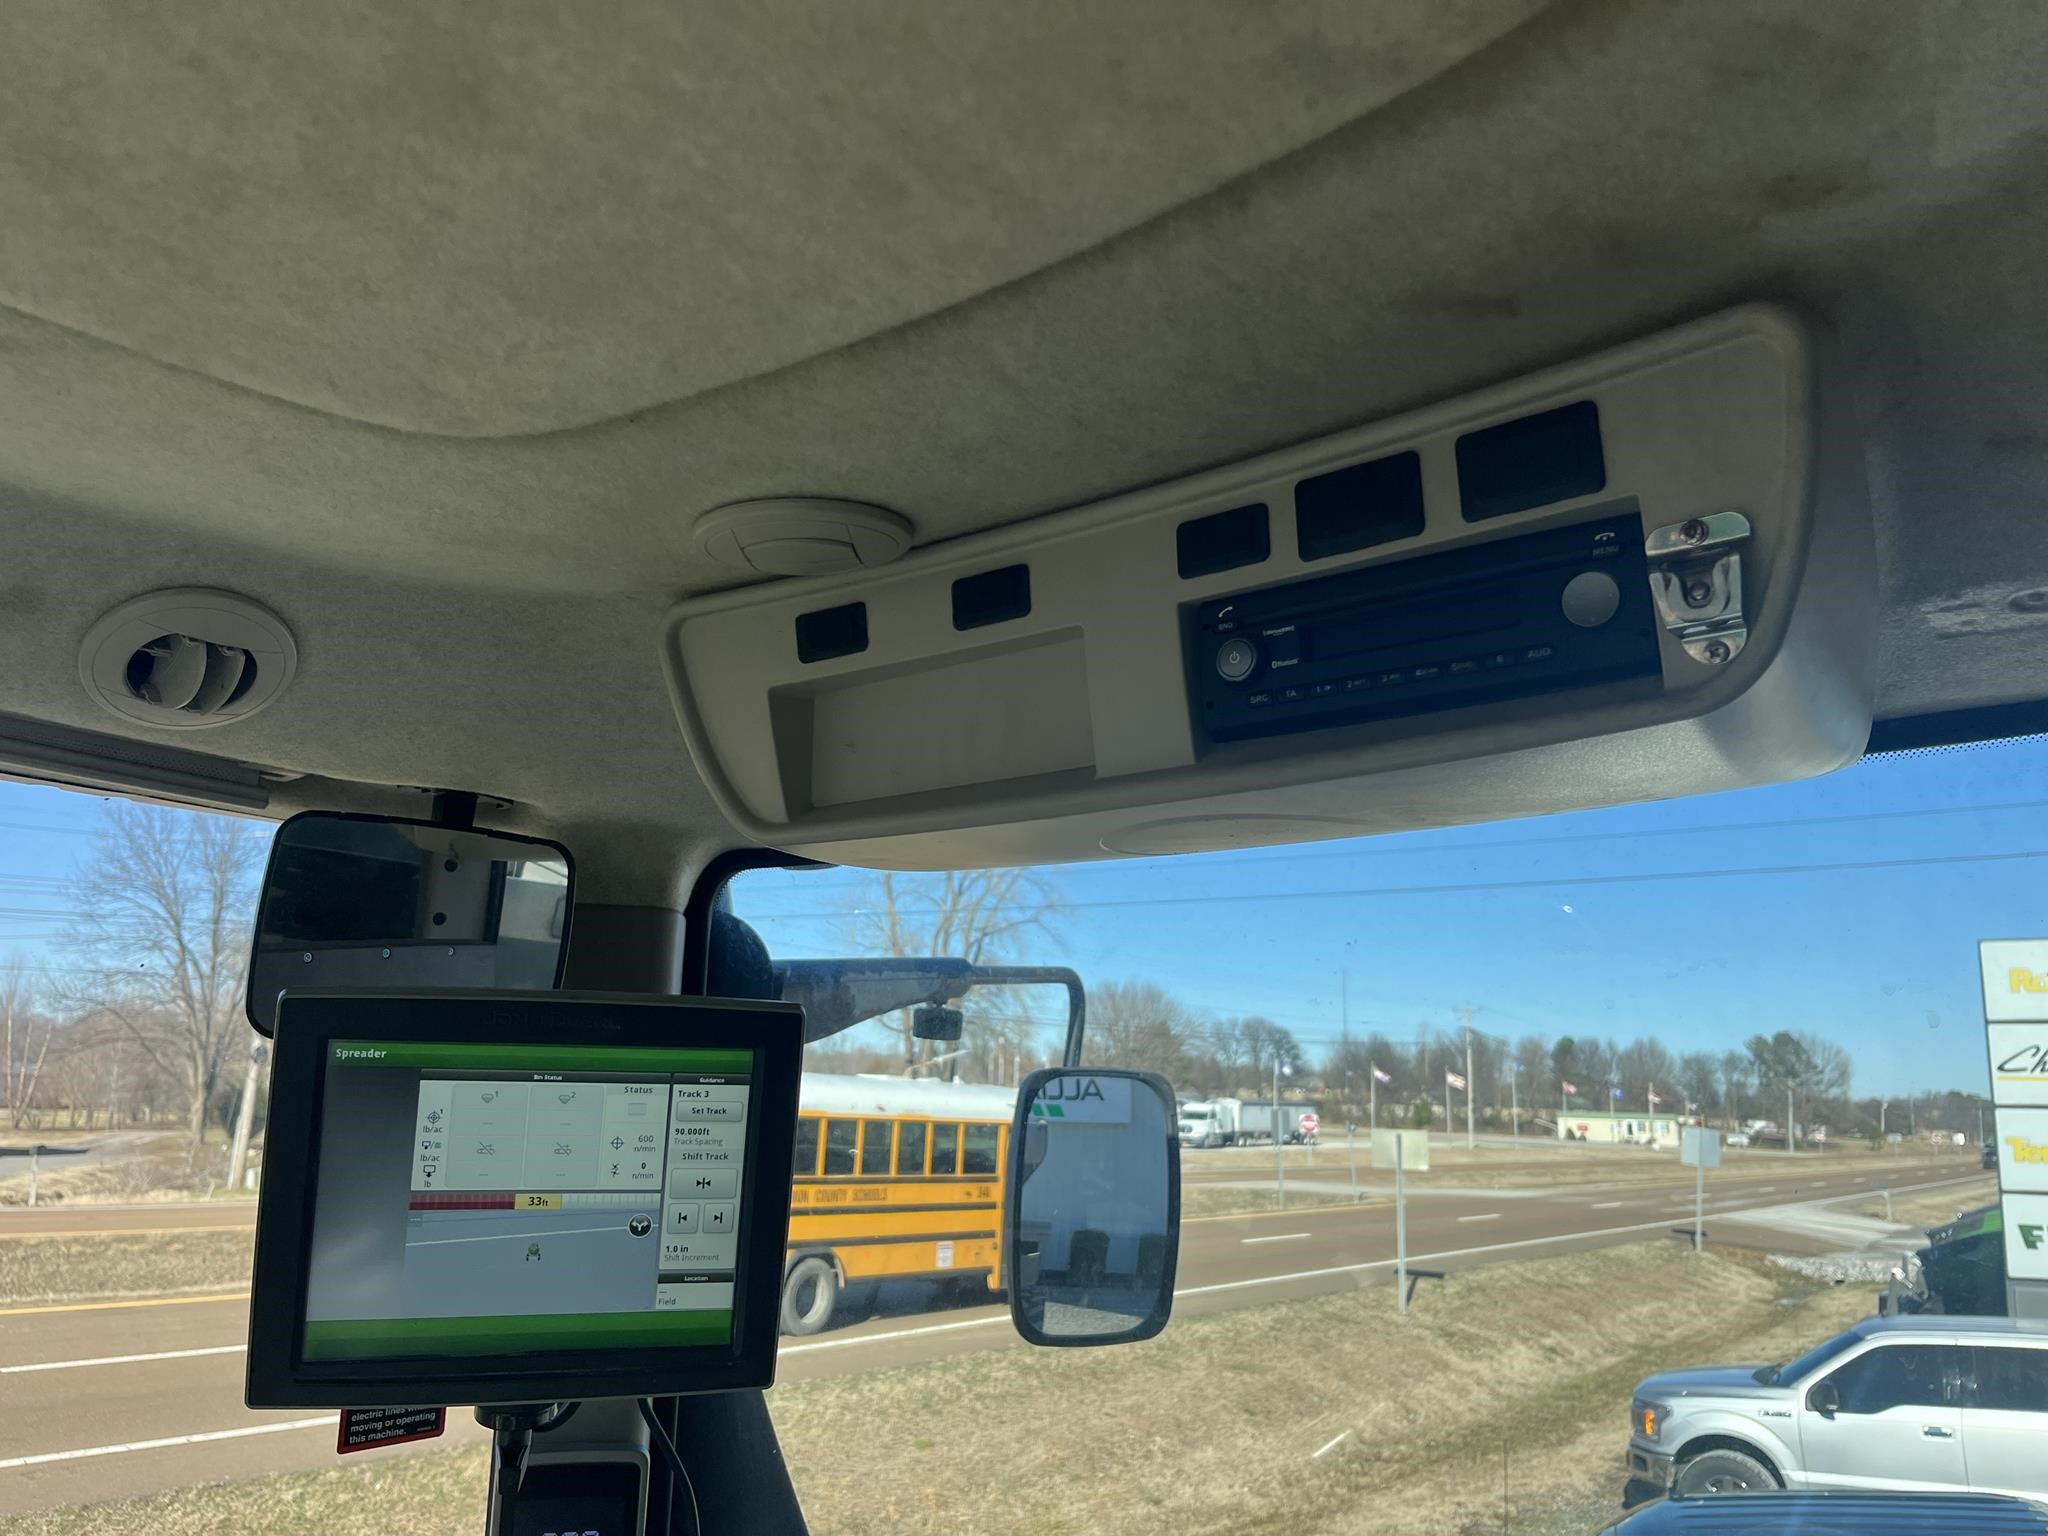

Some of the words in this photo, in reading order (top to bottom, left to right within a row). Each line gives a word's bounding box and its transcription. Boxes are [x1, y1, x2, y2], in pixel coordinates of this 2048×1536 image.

[1249, 694, 1269, 704] SRC
[335, 1048, 387, 1060] Spreader
[624, 1085, 654, 1095] Status
[678, 1089, 701, 1098] Track
[704, 1090, 710, 1098] 3
[691, 1107, 704, 1115] Set
[706, 1107, 727, 1115] Track
[422, 1125, 443, 1134] lb/ac
[674, 1127, 710, 1136] 90.000ft
[638, 1135, 654, 1143] 600
[673, 1137, 693, 1145] Track
[695, 1138, 724, 1147] Spacing
[420, 1153, 441, 1162] lb/ac
[682, 1152, 703, 1161] Shift
[705, 1152, 729, 1161] Track
[641, 1161, 647, 1170] 0
[632, 1171, 654, 1180] n/min
[424, 1180, 432, 1188] lb
[815, 1188, 848, 1203] COUNTY
[852, 1187, 888, 1201] SCHOOLS
[665, 1245, 679, 1253] 1.0
[680, 1244, 689, 1253] in
[664, 1254, 680, 1262] Shift
[681, 1253, 720, 1262] Increment
[351, 1409, 384, 1422] electric
[385, 1408, 406, 1416] lines
[350, 1421, 383, 1433] moving
[384, 1418, 395, 1427] or
[396, 1412, 436, 1426] operating
[349, 1434, 366, 1444] this
[367, 1428, 407, 1441] machine.
